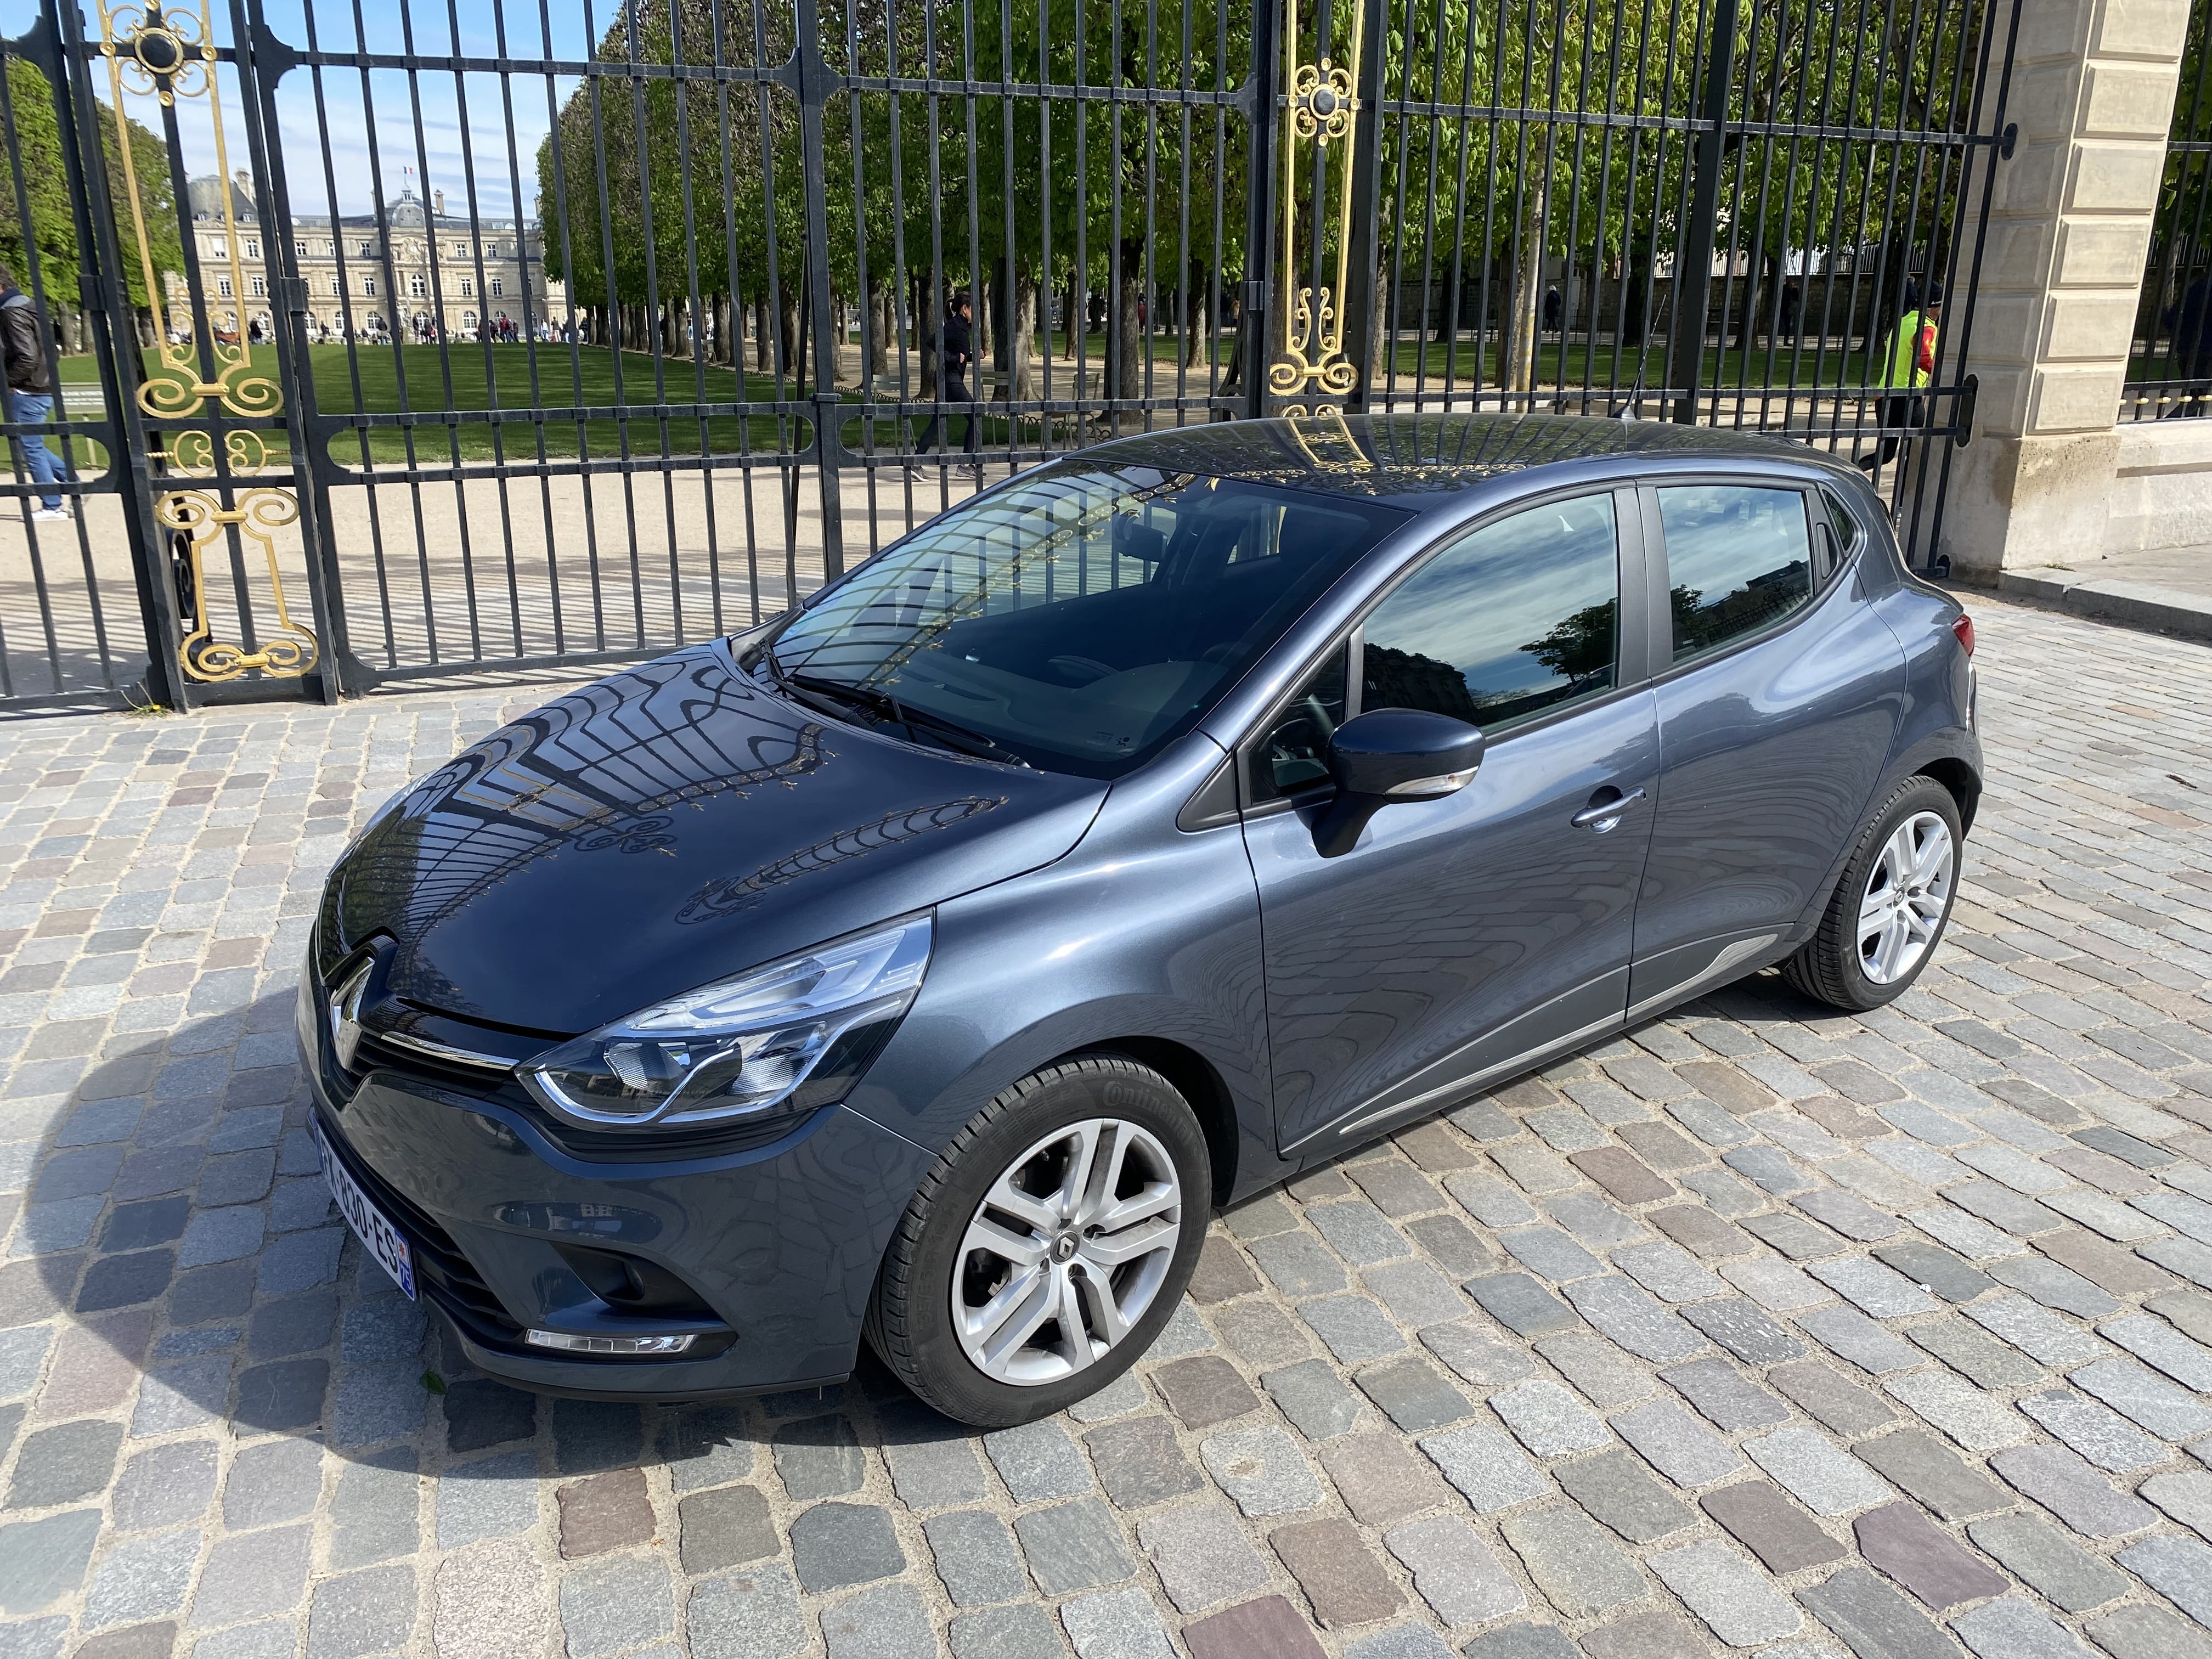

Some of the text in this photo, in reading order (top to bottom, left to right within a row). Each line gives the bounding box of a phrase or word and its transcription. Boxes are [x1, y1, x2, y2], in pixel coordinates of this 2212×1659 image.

[1103, 1080, 1195, 1143] Continental
[320, 1137, 398, 1273] FK-830-ES
[401, 1263, 411, 1291] 75
